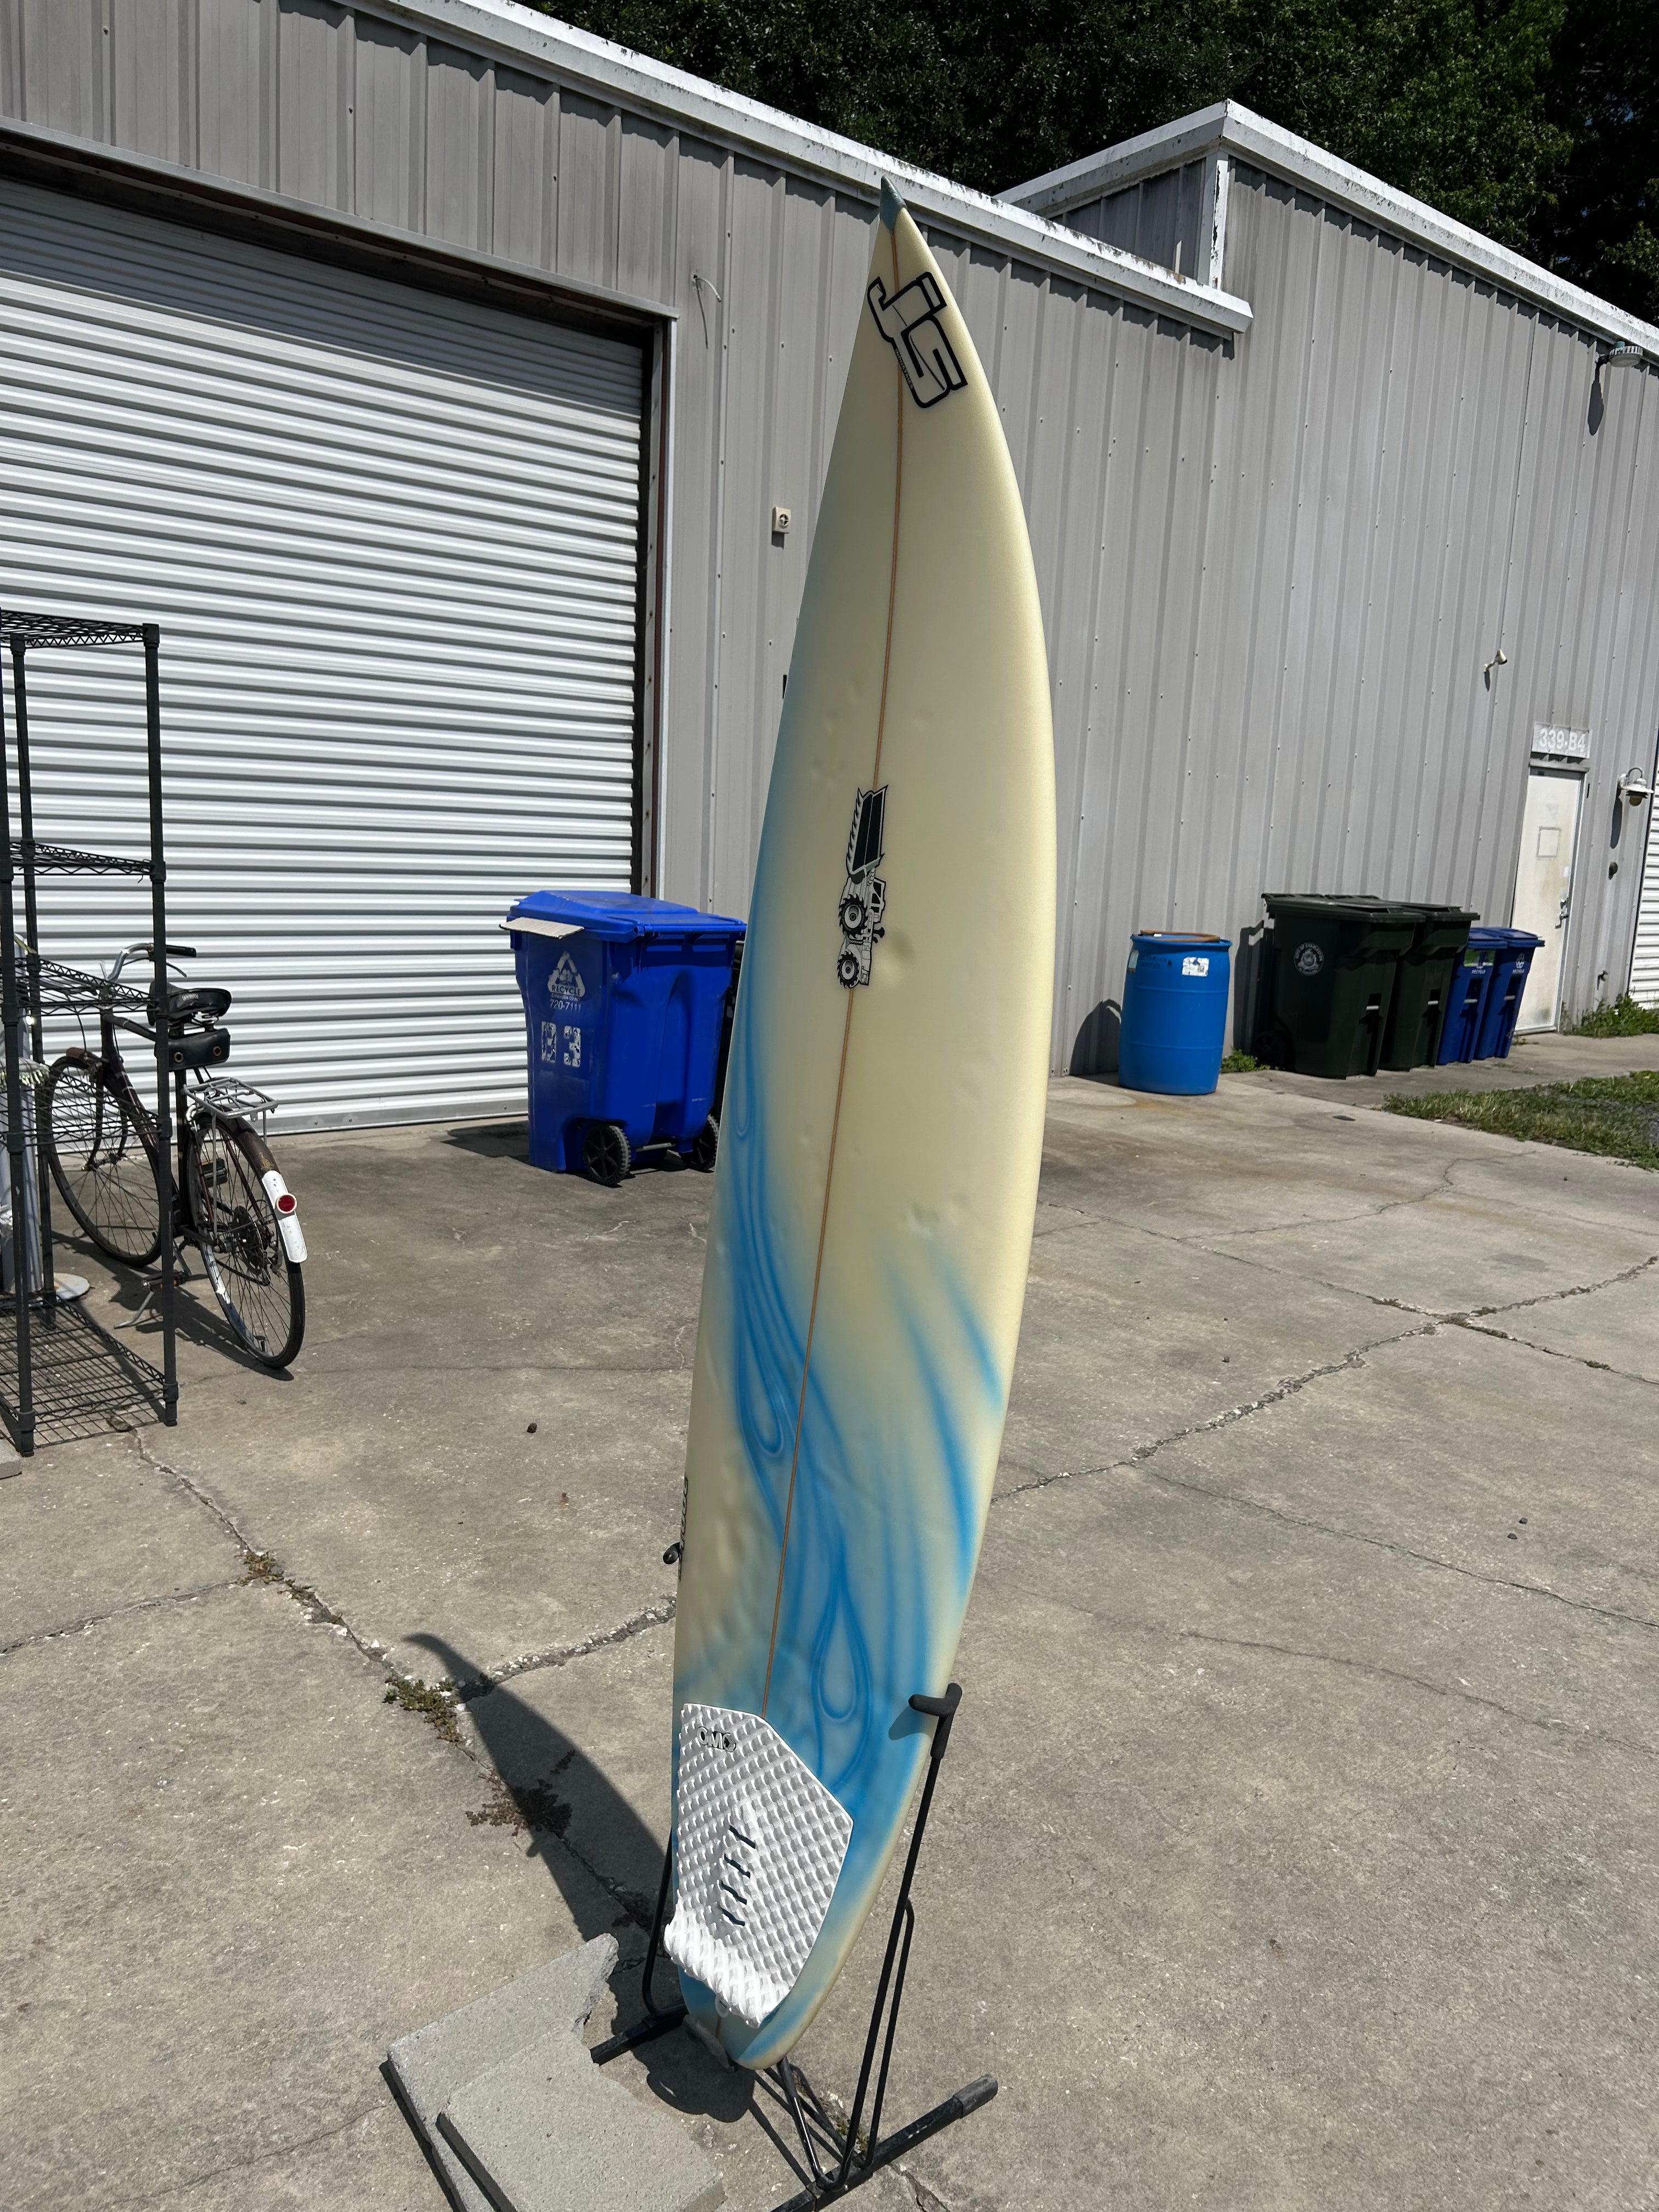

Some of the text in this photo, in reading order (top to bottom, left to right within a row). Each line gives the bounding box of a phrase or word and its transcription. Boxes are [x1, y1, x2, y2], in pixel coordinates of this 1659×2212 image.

[1539, 729, 1586, 752] 339-B4
[552, 984, 580, 996] RECYCLE
[550, 998, 581, 1012] 720-7111
